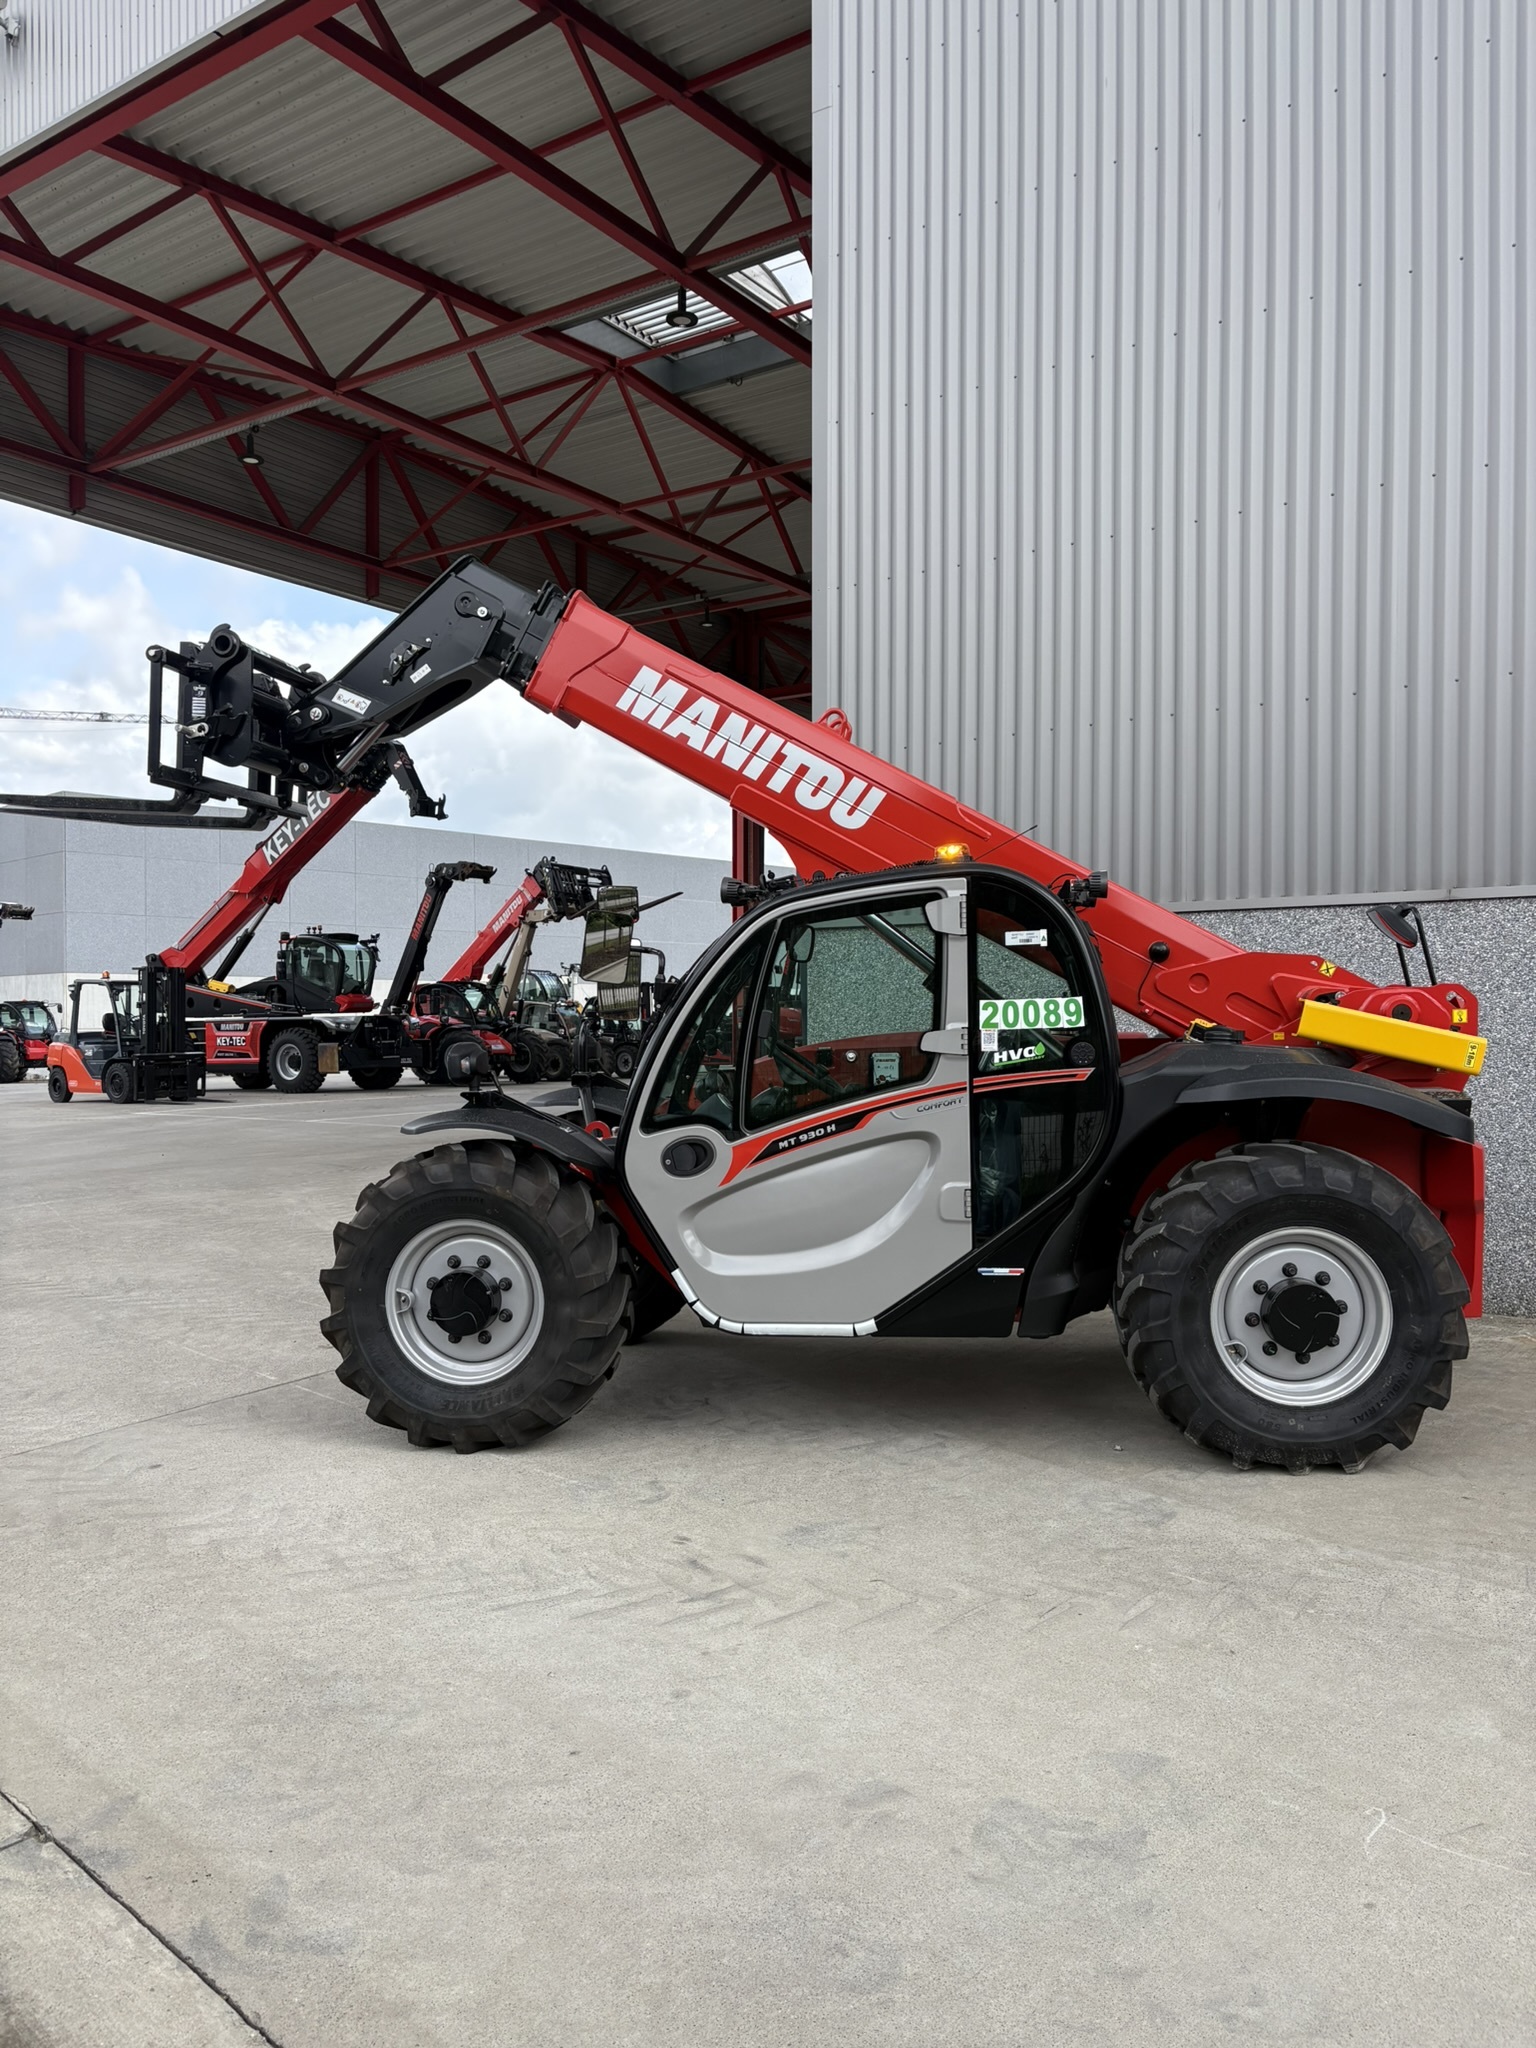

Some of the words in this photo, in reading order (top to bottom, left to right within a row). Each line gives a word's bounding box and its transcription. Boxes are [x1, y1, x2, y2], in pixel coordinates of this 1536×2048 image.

[615, 665, 887, 830] MANITOU
[411, 893, 432, 940] MANITOU
[491, 894, 523, 934] MANITOU
[220, 1023, 245, 1031] MANITOU
[981, 998, 1083, 1029] 20089
[216, 1036, 246, 1046] KEY-TEC
[1466, 1045, 1477, 1065] 9-18m
[916, 1096, 964, 1113] COMFORT
[778, 1135, 797, 1150] MT
[799, 1128, 825, 1143] 930
[826, 1123, 836, 1134] H
